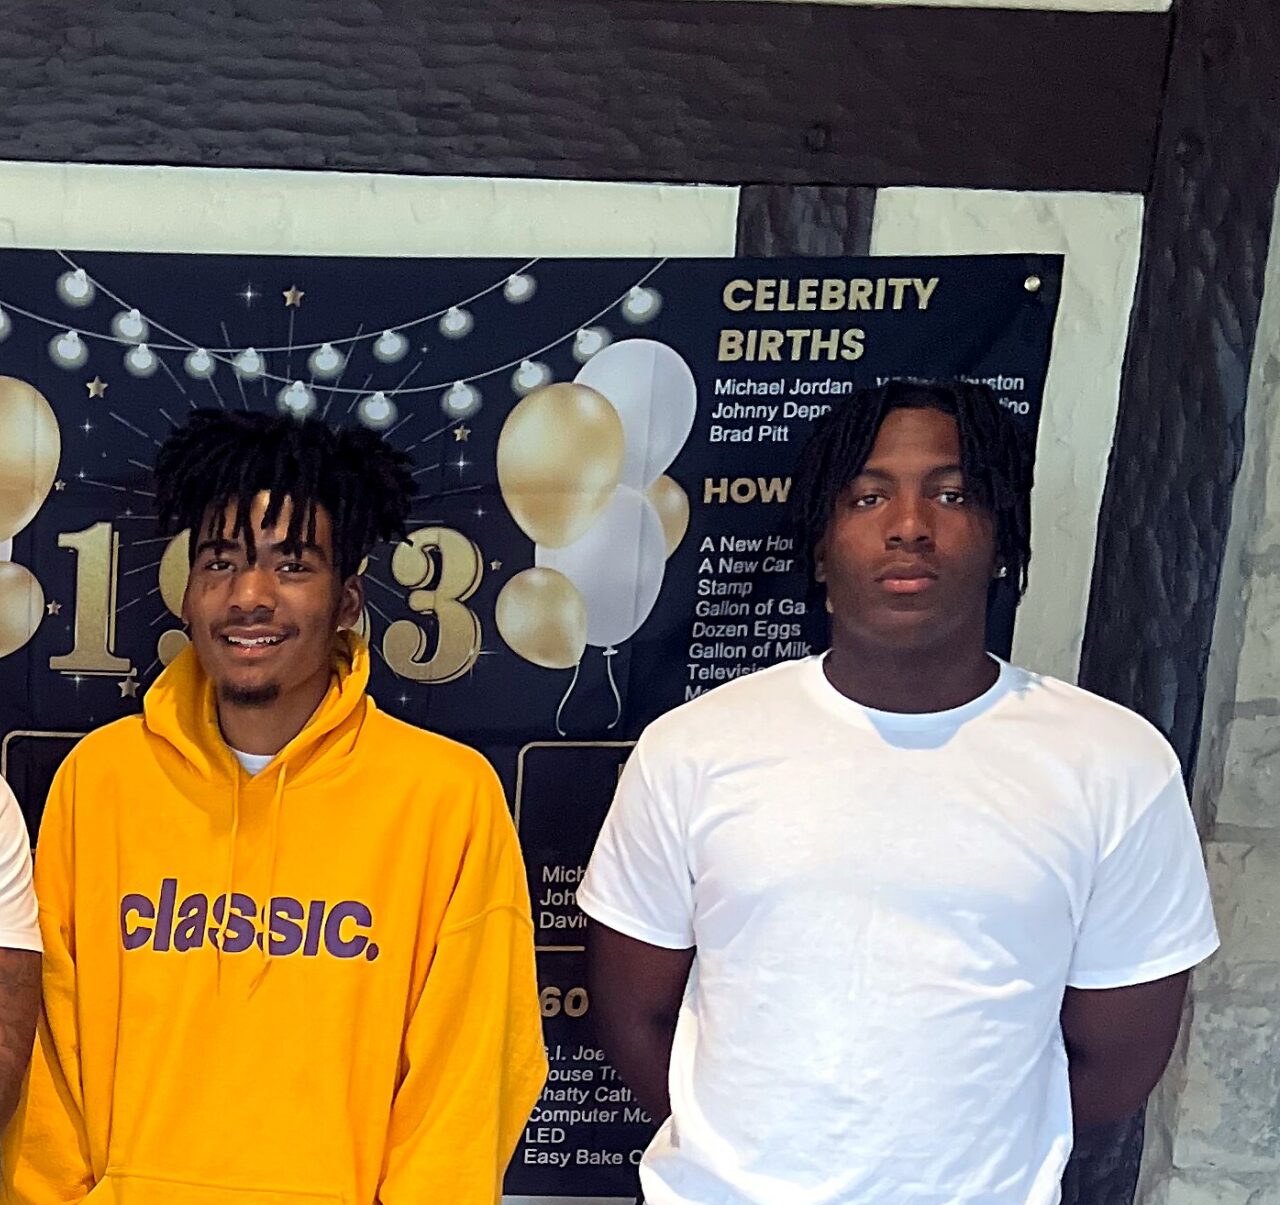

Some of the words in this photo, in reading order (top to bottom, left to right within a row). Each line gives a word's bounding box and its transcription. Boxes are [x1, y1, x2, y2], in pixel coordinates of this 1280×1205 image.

[722, 277, 940, 312] CELEBRITY
[717, 328, 866, 362] BIRTHS
[714, 378, 785, 396] Michael
[789, 378, 853, 395] Jordan
[712, 402, 778, 422] Johnny
[709, 425, 753, 442] Brad
[757, 425, 789, 442] Pitt
[703, 477, 792, 504] HOW
[700, 536, 715, 552] A
[720, 536, 763, 552] New
[698, 558, 714, 574] A
[718, 557, 758, 573] New
[762, 557, 794, 572] Car
[697, 579, 753, 598] Stamp
[695, 600, 750, 616] Gallon
[754, 599, 774, 616] of
[692, 622, 748, 638] Dozen
[754, 620, 801, 639] Eggs
[689, 642, 747, 658] Gallon
[752, 642, 771, 658] of
[775, 641, 812, 657] Milk
[542, 865, 586, 883] Mich
[120, 878, 379, 961] classic.
[548, 1069, 593, 1081] ouse
[538, 1087, 590, 1105] hatty
[528, 1107, 619, 1125] Computer
[525, 1128, 566, 1143] LED
[523, 1149, 571, 1168] Easy
[576, 1150, 623, 1165] Bake
